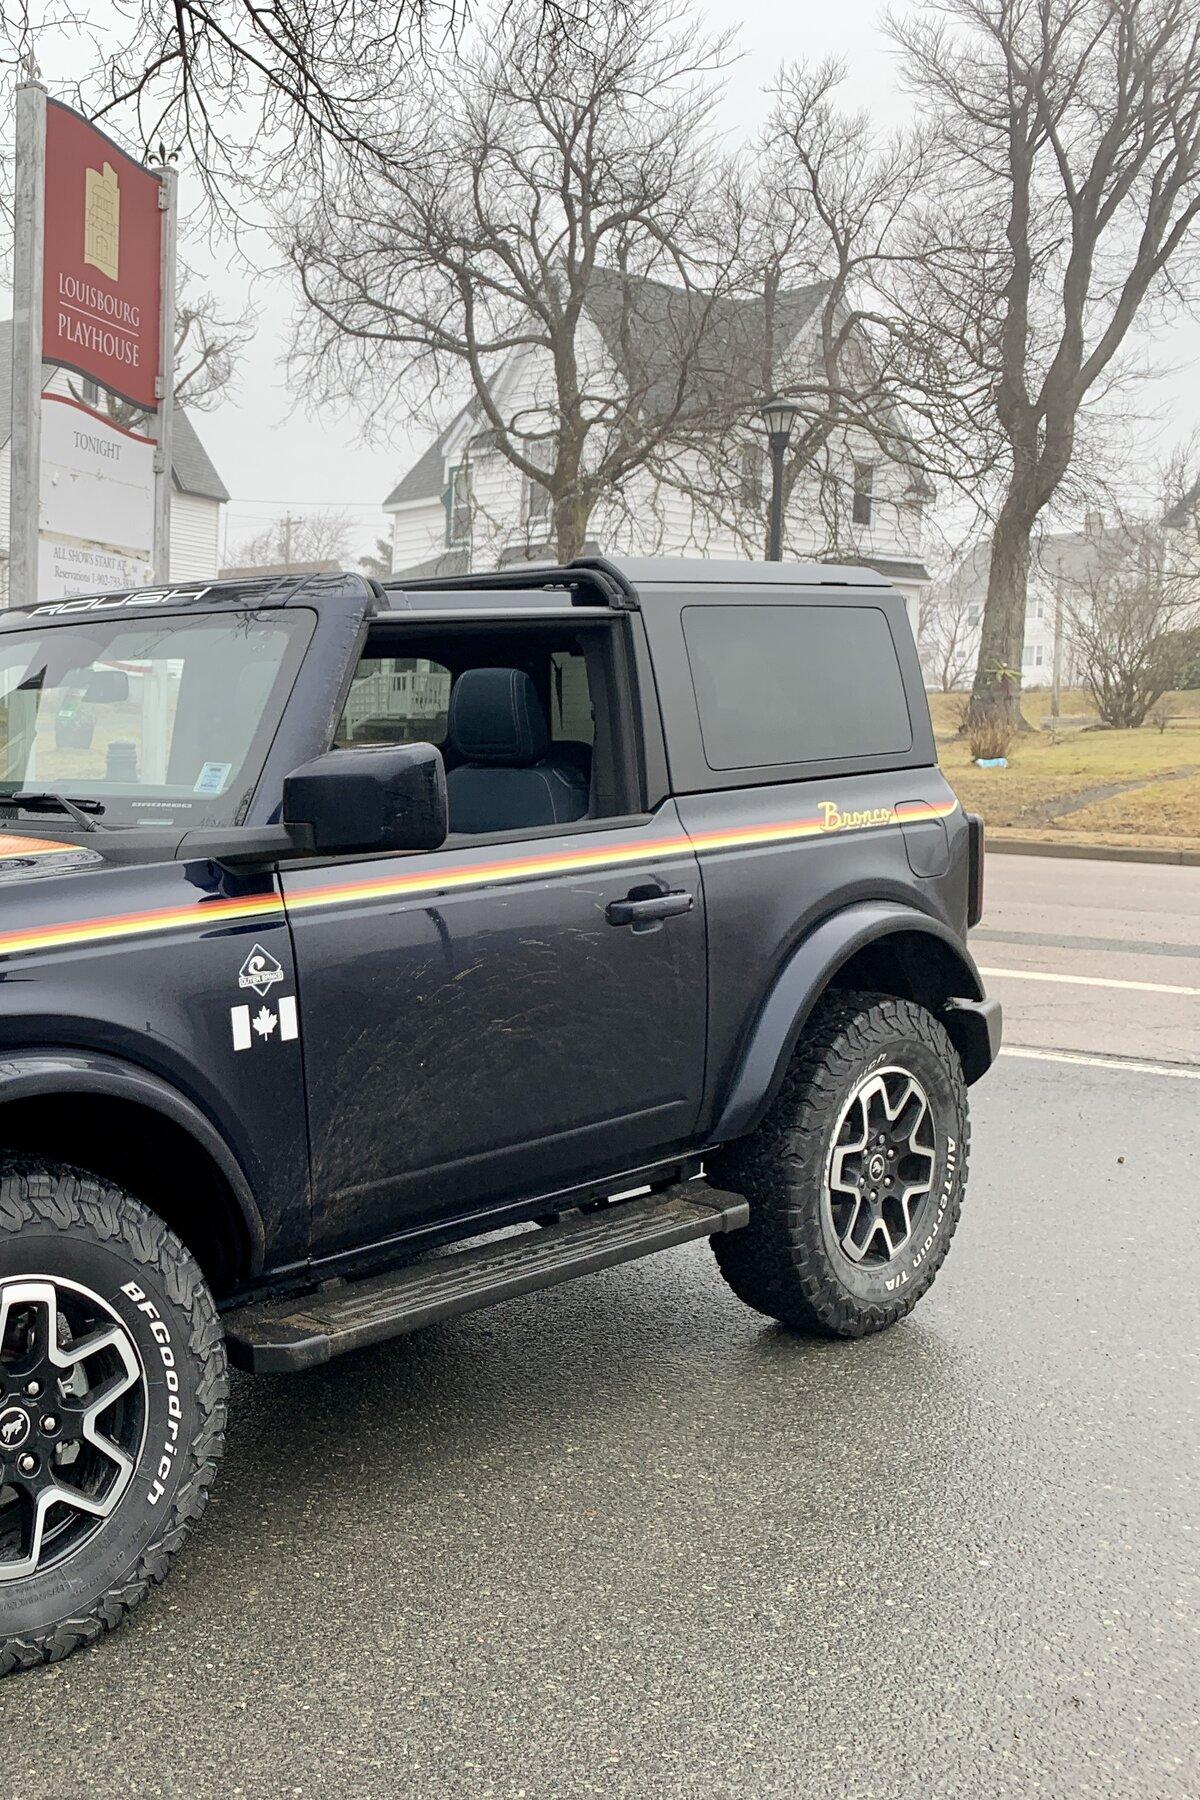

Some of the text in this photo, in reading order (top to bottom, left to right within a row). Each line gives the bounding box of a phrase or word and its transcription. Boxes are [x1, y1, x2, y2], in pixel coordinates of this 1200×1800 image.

[59, 273, 140, 327] LOUISBOURG
[58, 312, 140, 367] PLAYHOUSE
[73, 431, 122, 460] TONIGHT
[53, 547, 66, 560] ALL
[68, 549, 94, 566] SHOWS
[95, 554, 116, 570] START
[54, 565, 91, 583] Reservations
[26, 587, 212, 619] ROUSH
[817, 801, 892, 832] Bronco
[241, 975, 261, 986] OUTER
[884, 1136, 957, 1292] All-Terrain T/A
[119, 1281, 183, 1506] BFGoodrich
